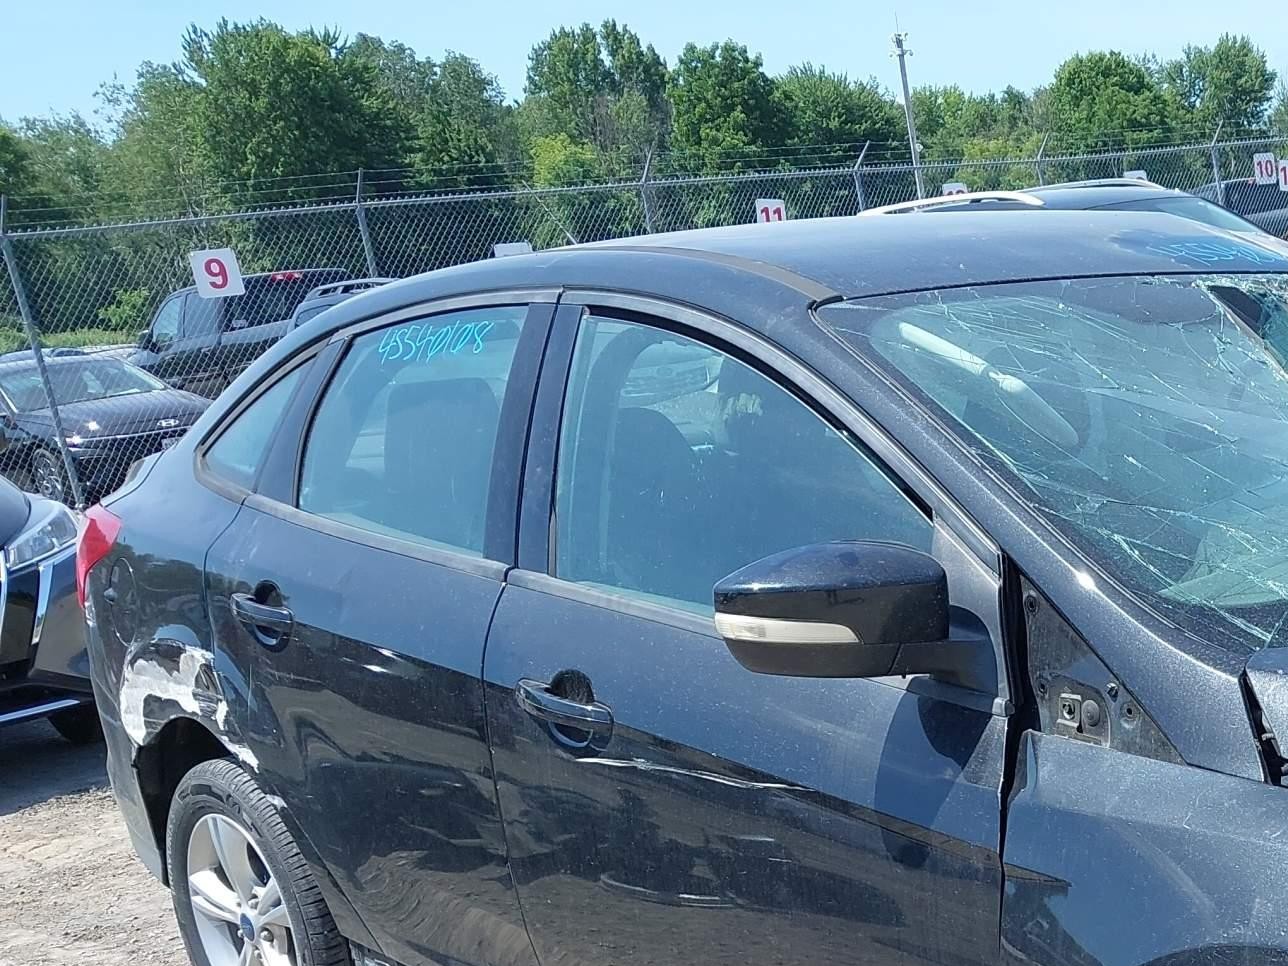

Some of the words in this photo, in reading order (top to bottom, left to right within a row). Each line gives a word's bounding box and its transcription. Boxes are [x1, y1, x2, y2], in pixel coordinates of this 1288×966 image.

[1257, 160, 1274, 178] 10
[761, 206, 782, 223] 11
[204, 258, 229, 289] 9
[379, 319, 495, 366] 45540108
